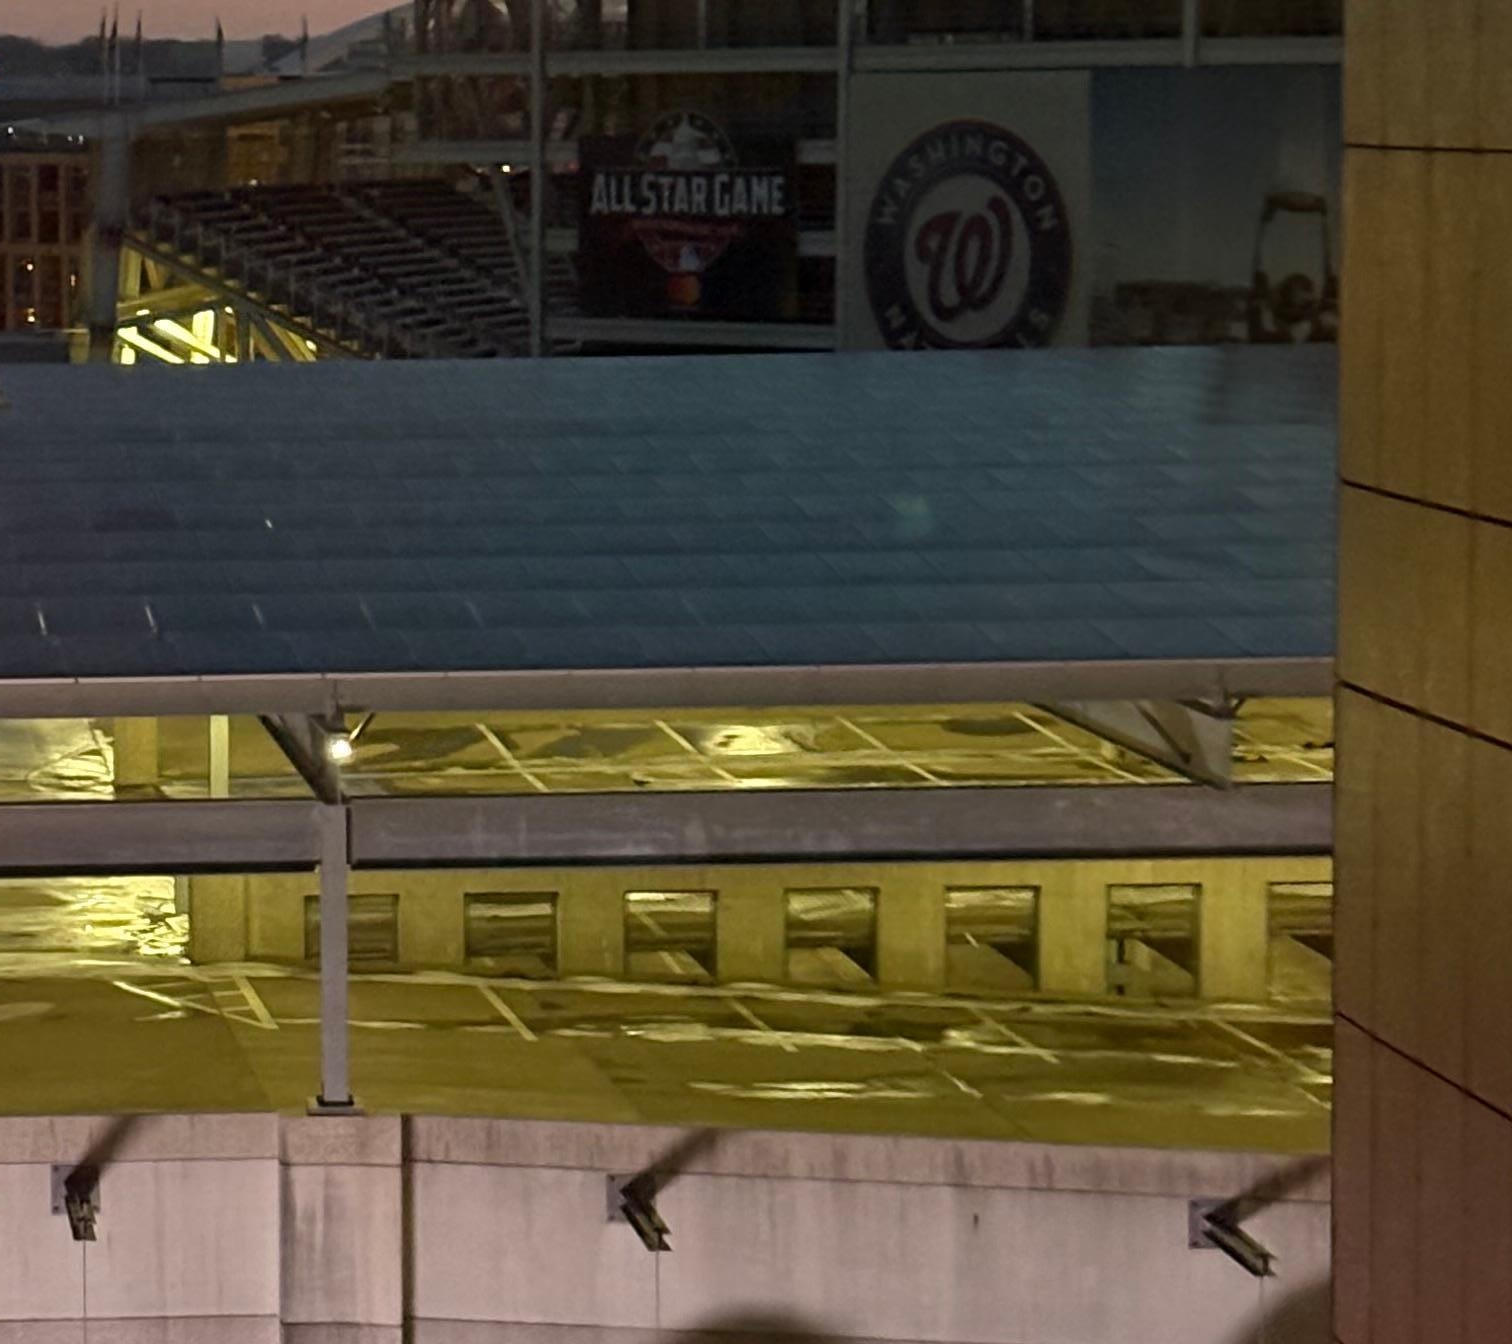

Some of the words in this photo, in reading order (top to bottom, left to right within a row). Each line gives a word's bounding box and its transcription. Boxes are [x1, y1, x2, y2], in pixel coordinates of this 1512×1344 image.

[589, 173, 638, 215] ALL
[640, 173, 709, 216] STAR
[712, 173, 787, 216] GAME
[875, 132, 1059, 231] WASHINGTON
[915, 197, 1012, 322] W
